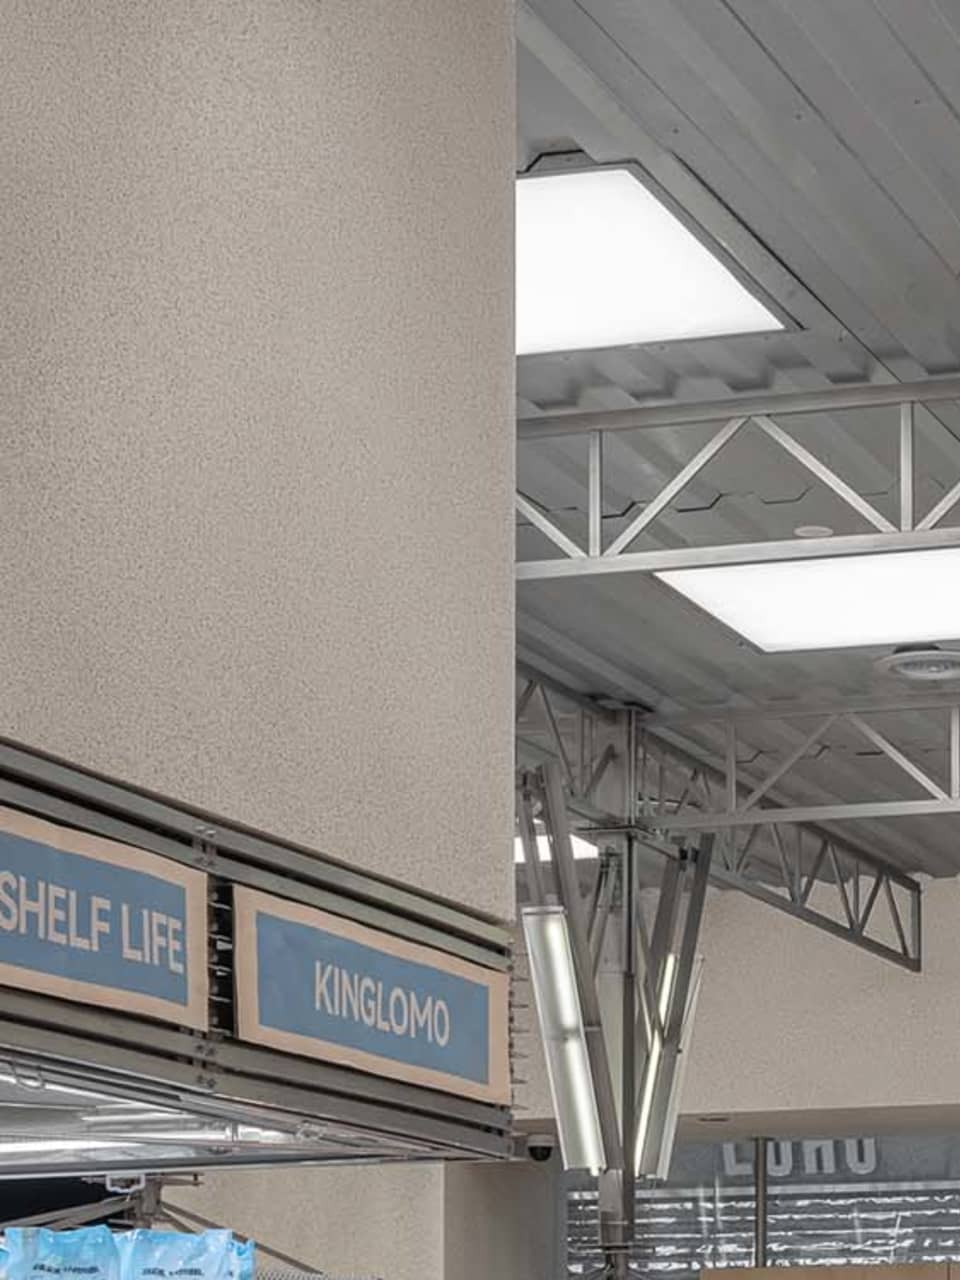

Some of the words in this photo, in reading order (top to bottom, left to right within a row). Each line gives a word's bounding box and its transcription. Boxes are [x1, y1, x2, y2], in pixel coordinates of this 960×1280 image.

[0, 870, 111, 952] SHELF
[121, 903, 185, 974] LIFE
[315, 960, 450, 1047] KINGLOMO
